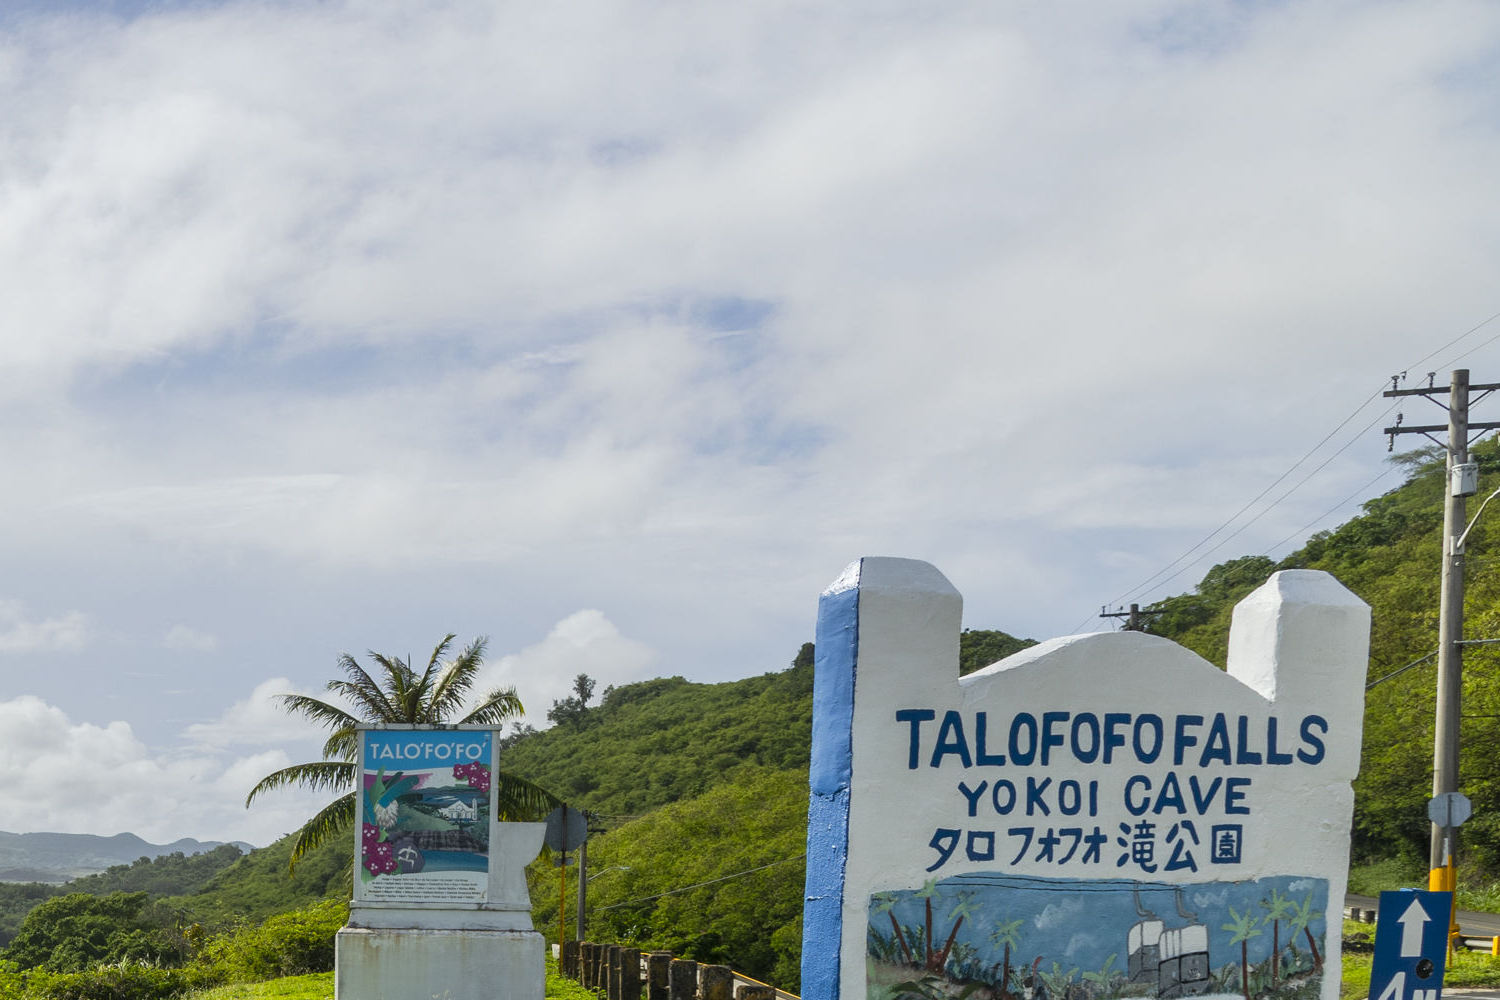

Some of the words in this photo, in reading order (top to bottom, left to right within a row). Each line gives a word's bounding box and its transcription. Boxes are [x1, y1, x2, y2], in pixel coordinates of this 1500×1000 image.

[895, 709, 1164, 769] TALOFOFO
[1173, 713, 1329, 767] FALLS
[957, 776, 1099, 818] YOKOI
[1123, 771, 1252, 817] CAVE
